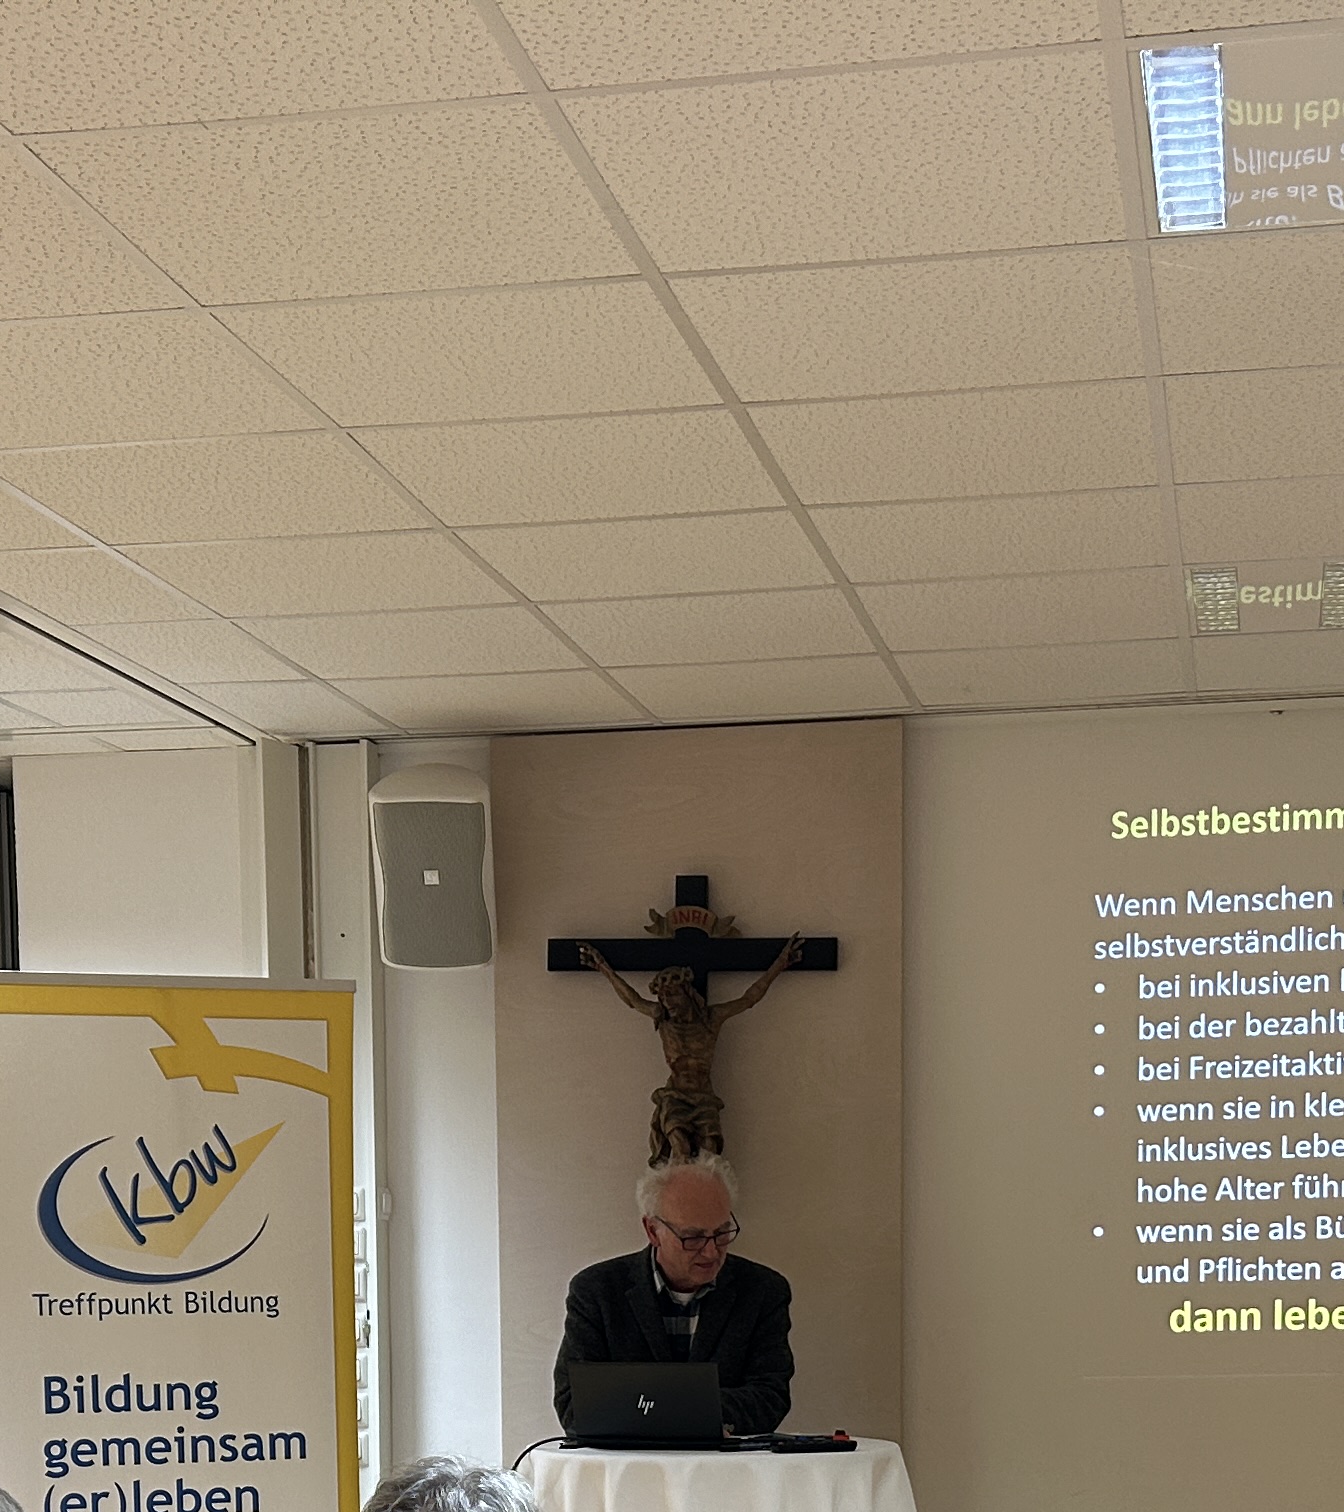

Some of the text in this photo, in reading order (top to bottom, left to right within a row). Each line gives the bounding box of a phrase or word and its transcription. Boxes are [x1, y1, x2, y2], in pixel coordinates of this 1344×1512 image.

[1094, 893, 1176, 918] Wenn
[1186, 884, 1333, 915] Menschen
[671, 908, 709, 926] INRI
[1138, 973, 1181, 1000] bei
[1189, 970, 1330, 998] inklusiven
[1138, 1014, 1180, 1041] bei
[1188, 1012, 1237, 1039] der
[1138, 1056, 1180, 1082] bei
[1136, 1102, 1214, 1123] wenn
[1222, 1095, 1262, 1120] sie
[1270, 1094, 1295, 1119] in
[1137, 1135, 1272, 1163] inklusives
[98, 1123, 237, 1247] kbw
[1137, 1176, 1208, 1203] hohe
[1214, 1175, 1286, 1202] Alter
[1135, 1224, 1213, 1244] wenn
[1221, 1217, 1261, 1242] sie
[1268, 1214, 1307, 1241] als
[1136, 1257, 1190, 1284] und
[1199, 1255, 1321, 1283] Pflichten
[31, 1290, 280, 1322] Treffpunkt Bildung
[1169, 1300, 1262, 1334] dann
[43, 1372, 220, 1421] Bildung
[637, 1394, 655, 1415] hp
[43, 1425, 308, 1479] gemeinsam
